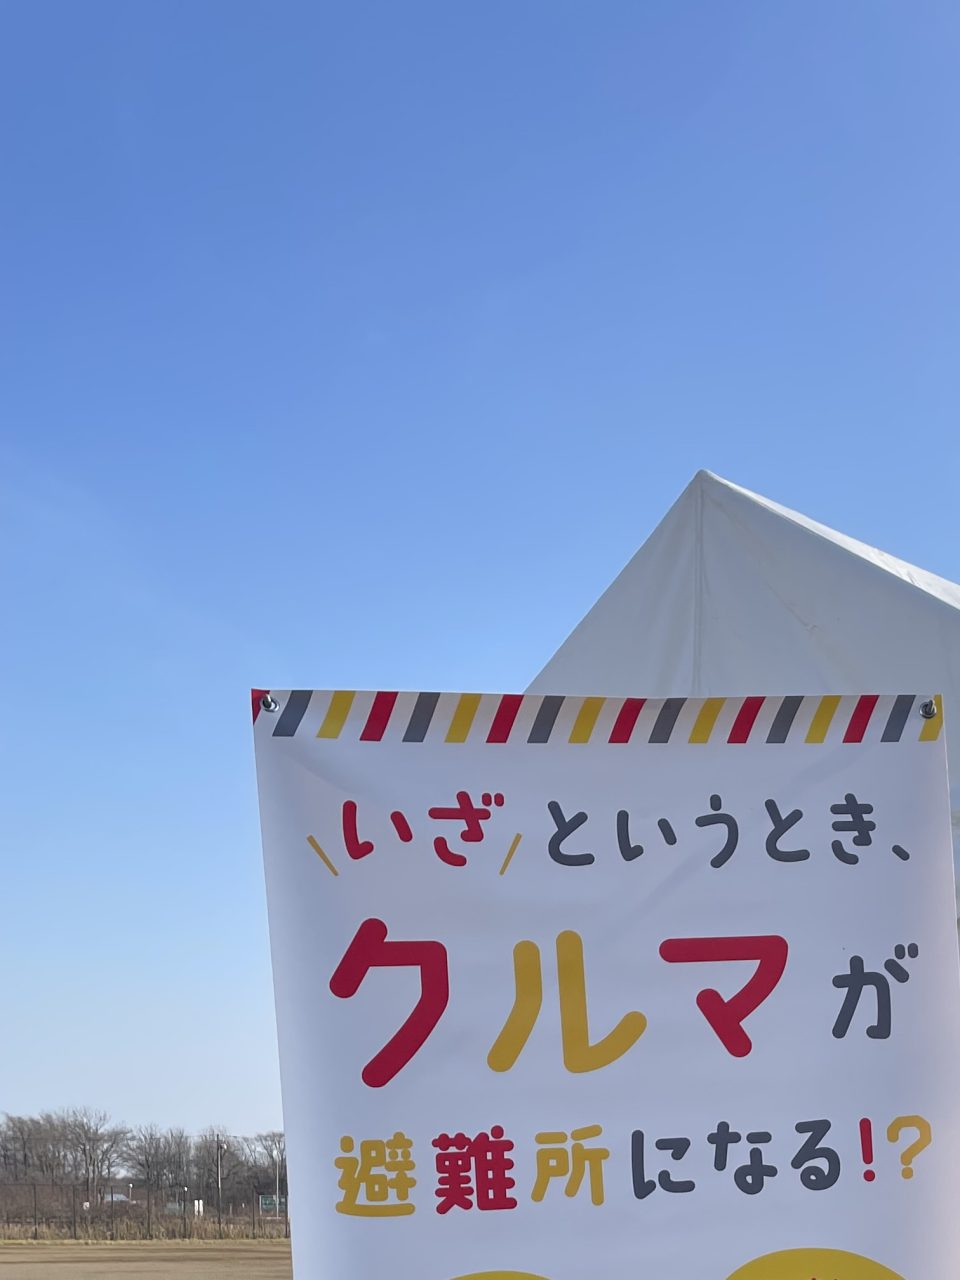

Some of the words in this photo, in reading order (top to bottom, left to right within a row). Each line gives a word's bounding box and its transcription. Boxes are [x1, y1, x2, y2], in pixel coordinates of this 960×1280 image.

[342, 791, 911, 868] いざというとき、
[329, 917, 919, 1088] クルマが
[334, 1114, 933, 1218] 避難所になる!?
